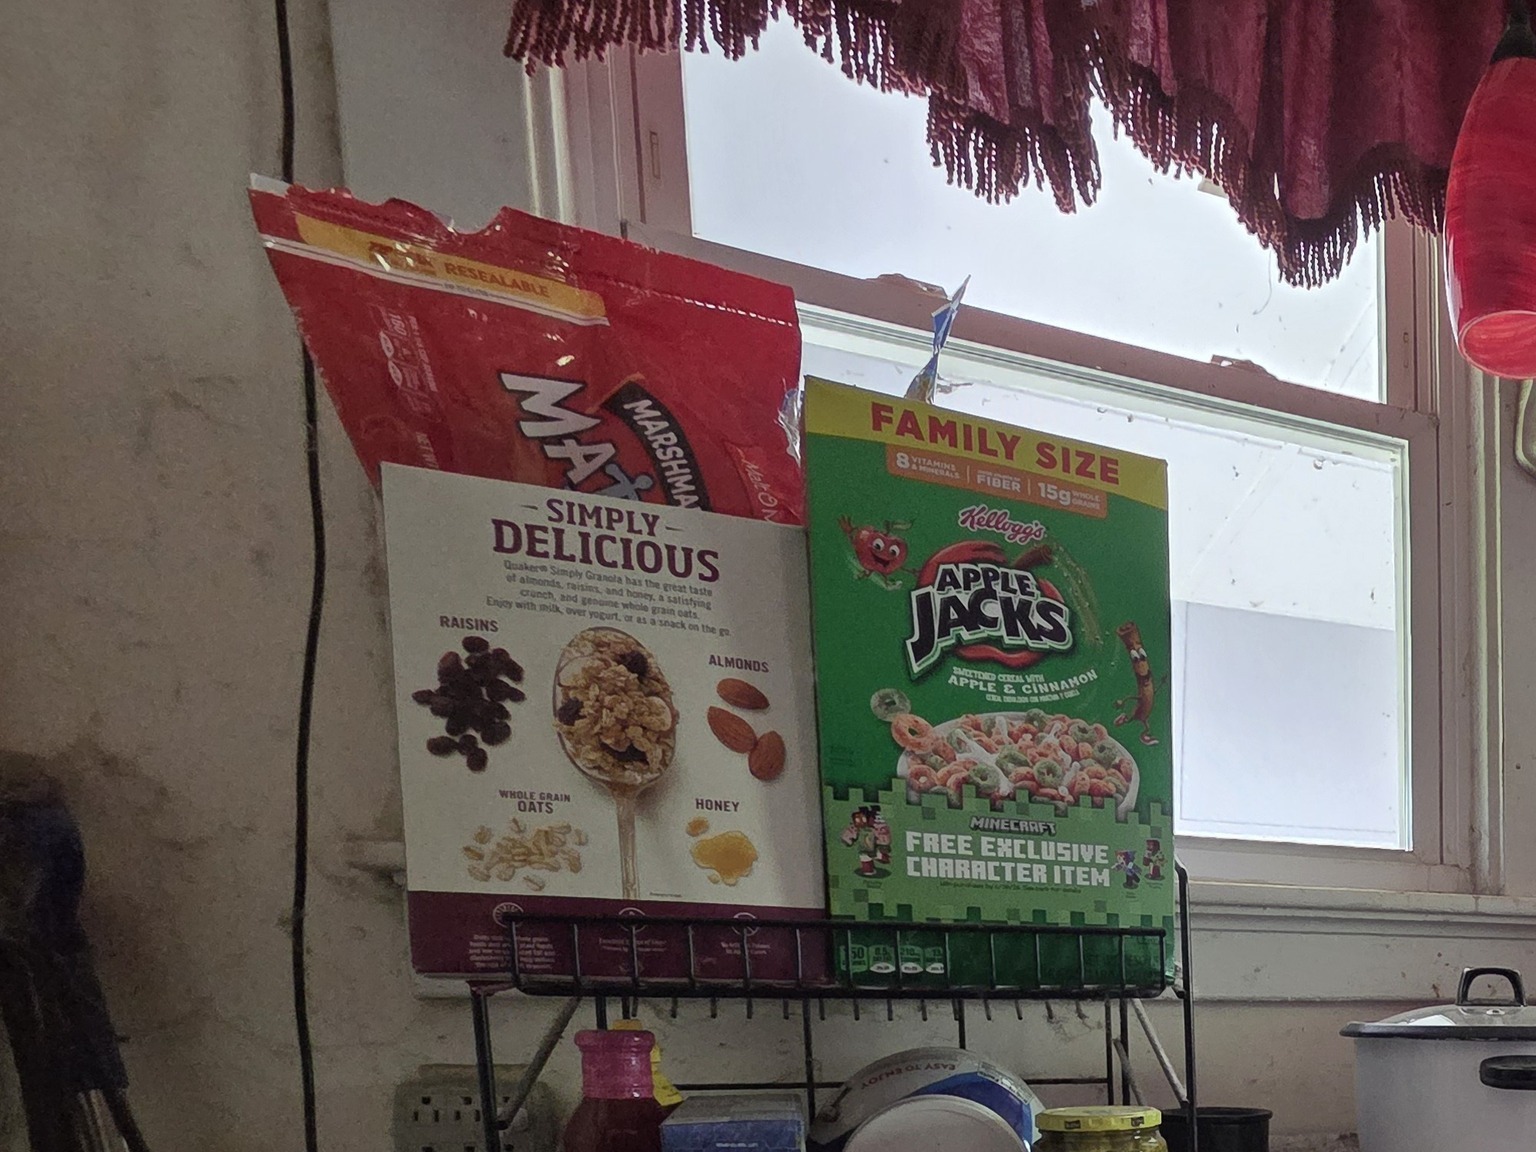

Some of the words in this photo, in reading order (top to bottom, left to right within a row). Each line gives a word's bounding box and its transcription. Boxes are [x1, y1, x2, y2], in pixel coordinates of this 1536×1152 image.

[443, 261, 551, 299] RESEALABLE
[871, 401, 1022, 462] FAMILY
[1035, 440, 1121, 486] SIZE
[896, 452, 911, 470] 8
[911, 455, 957, 472] VITAMINS
[976, 474, 1021, 493] FIBER
[1037, 481, 1072, 507] 15g
[546, 497, 661, 538] SIMPLY
[958, 503, 1047, 546] Kellogg's
[491, 517, 721, 583] DELICIOUS
[550, 565, 584, 581] Simply
[585, 570, 623, 585] Granola
[625, 575, 643, 587] has
[645, 578, 661, 590] the
[663, 582, 687, 595] great
[689, 584, 713, 598] taste
[605, 586, 624, 598] and
[935, 563, 1037, 599] APPLE
[439, 614, 499, 633] RAISINS
[516, 599, 537, 612] with
[566, 607, 587, 618] over
[688, 622, 700, 633] on
[701, 622, 717, 635] the
[906, 590, 1070, 665] JACKS
[708, 653, 770, 674] ALMONDS
[948, 674, 997, 694] APPLE
[1021, 668, 1099, 695] CINNAMON
[499, 788, 537, 802] WHOLE
[538, 790, 571, 804] GRAIN
[517, 799, 555, 815] OATS
[694, 797, 740, 813] HONEY
[970, 815, 1058, 837] MINECRAFT
[905, 830, 974, 856] FREE
[980, 835, 1110, 865] EXCLUSIVE
[906, 855, 1048, 884] CHARACTER
[1053, 865, 1111, 888] ITEM
